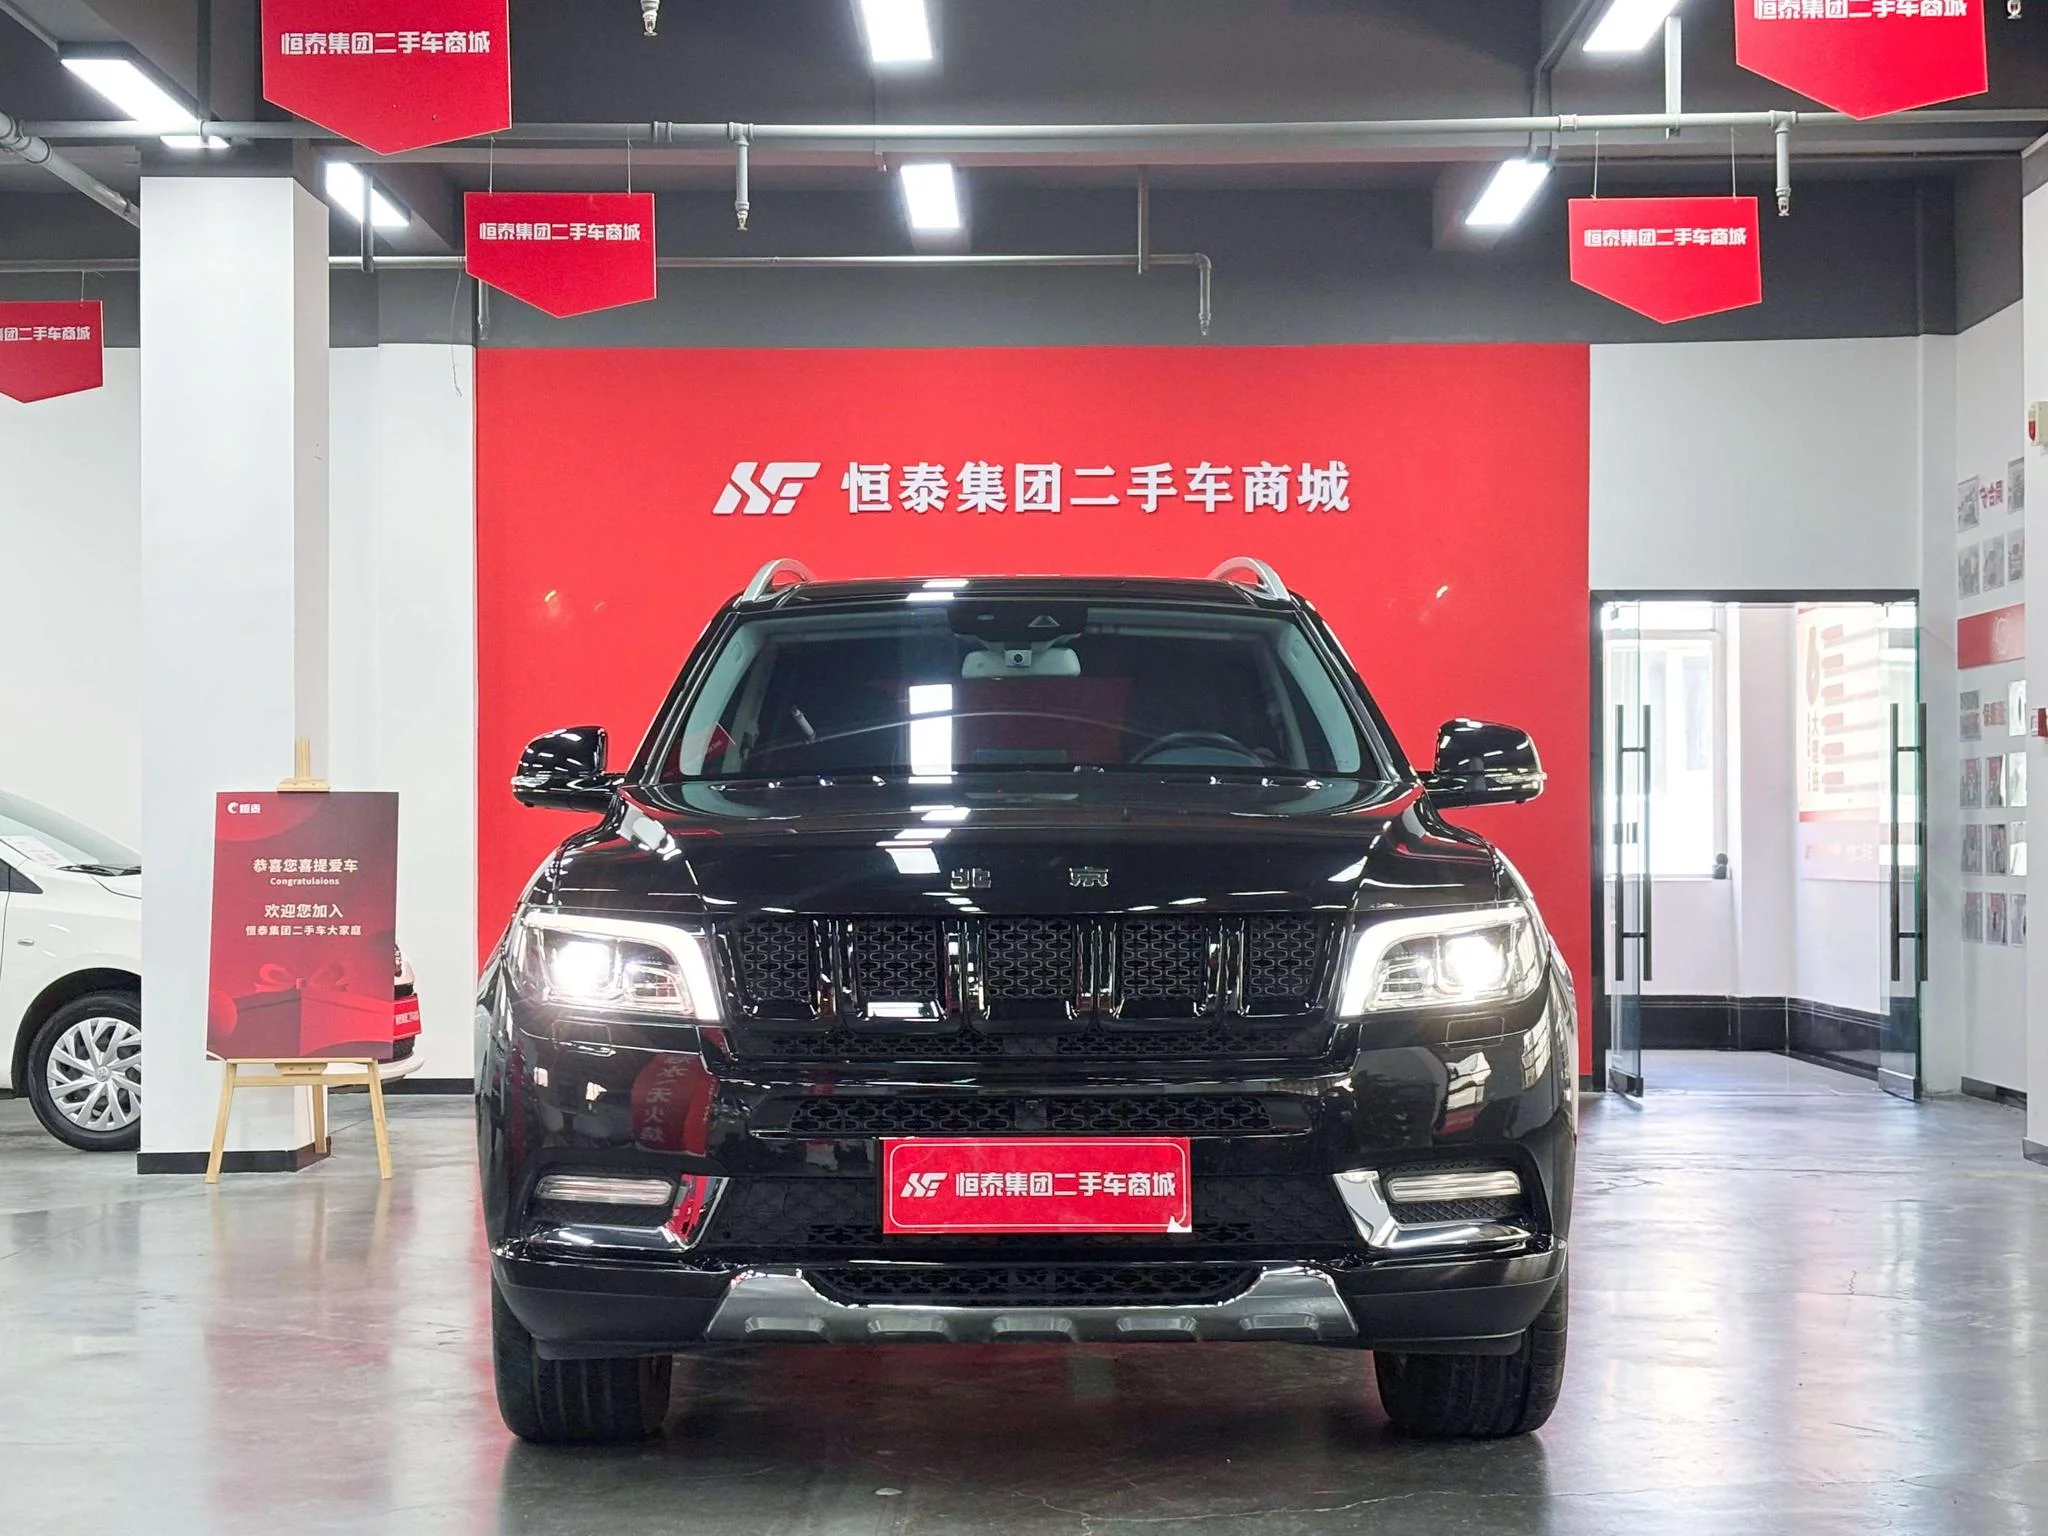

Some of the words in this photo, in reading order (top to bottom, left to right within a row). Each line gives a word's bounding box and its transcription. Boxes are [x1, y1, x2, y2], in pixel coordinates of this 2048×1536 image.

[1753, 0, 1967, 20] 恒泰集团二手车商城
[281, 30, 491, 56] 恒泰集团二手车商城
[479, 222, 641, 242] 恒泰集团二手车商城
[1583, 227, 1747, 247] 恒泰集团二手车商城
[0, 325, 91, 341] 团二手车商城
[840, 460, 1350, 513] 恒泰集团二手车商城
[253, 858, 358, 873] 恭喜您喜提爱车
[269, 876, 340, 887] Congratulaions
[264, 903, 344, 919] 欢迎您加入
[245, 925, 362, 936] 恒泰集团二手车大家庭
[955, 1171, 1176, 1197] 恒泰集团二手车商城
